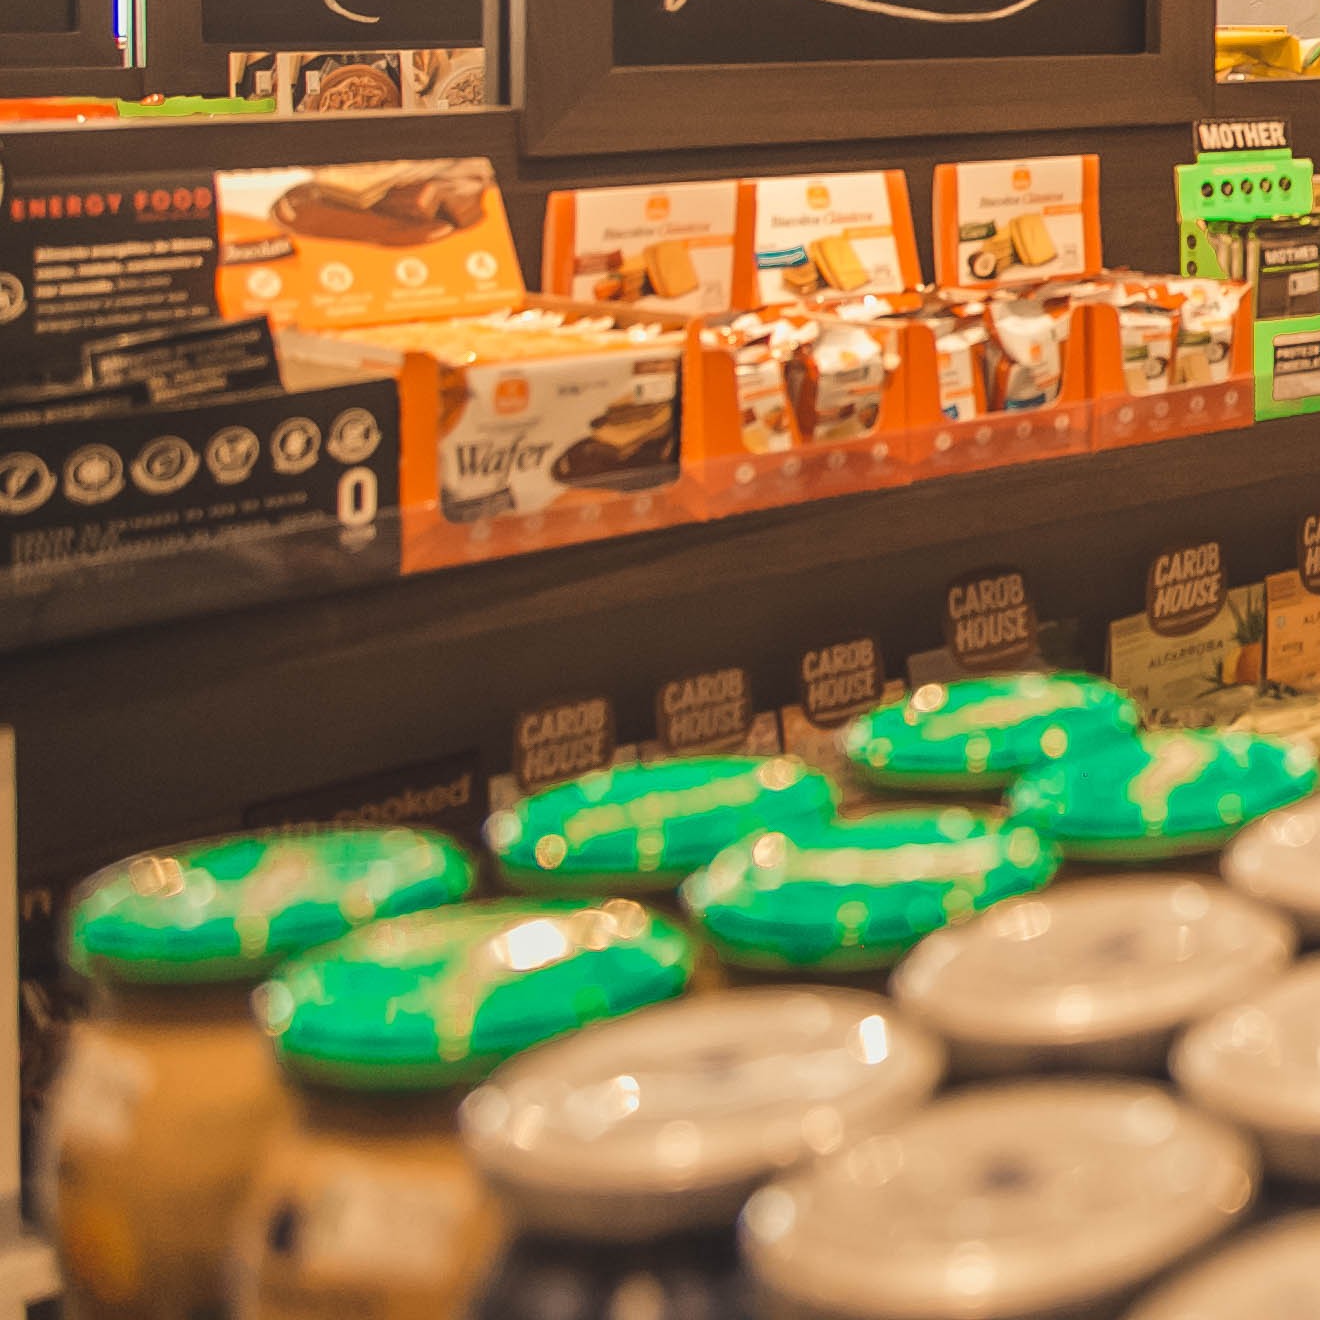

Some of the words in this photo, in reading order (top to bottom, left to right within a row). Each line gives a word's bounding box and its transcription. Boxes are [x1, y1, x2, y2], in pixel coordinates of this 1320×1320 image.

[1198, 120, 1287, 151] MOTHER
[456, 427, 555, 493] Wafer
[1154, 541, 1221, 586] CAROB
[948, 573, 1025, 619] CAROB
[1153, 573, 1222, 618] HOUSE
[955, 604, 1028, 651] HOUSE
